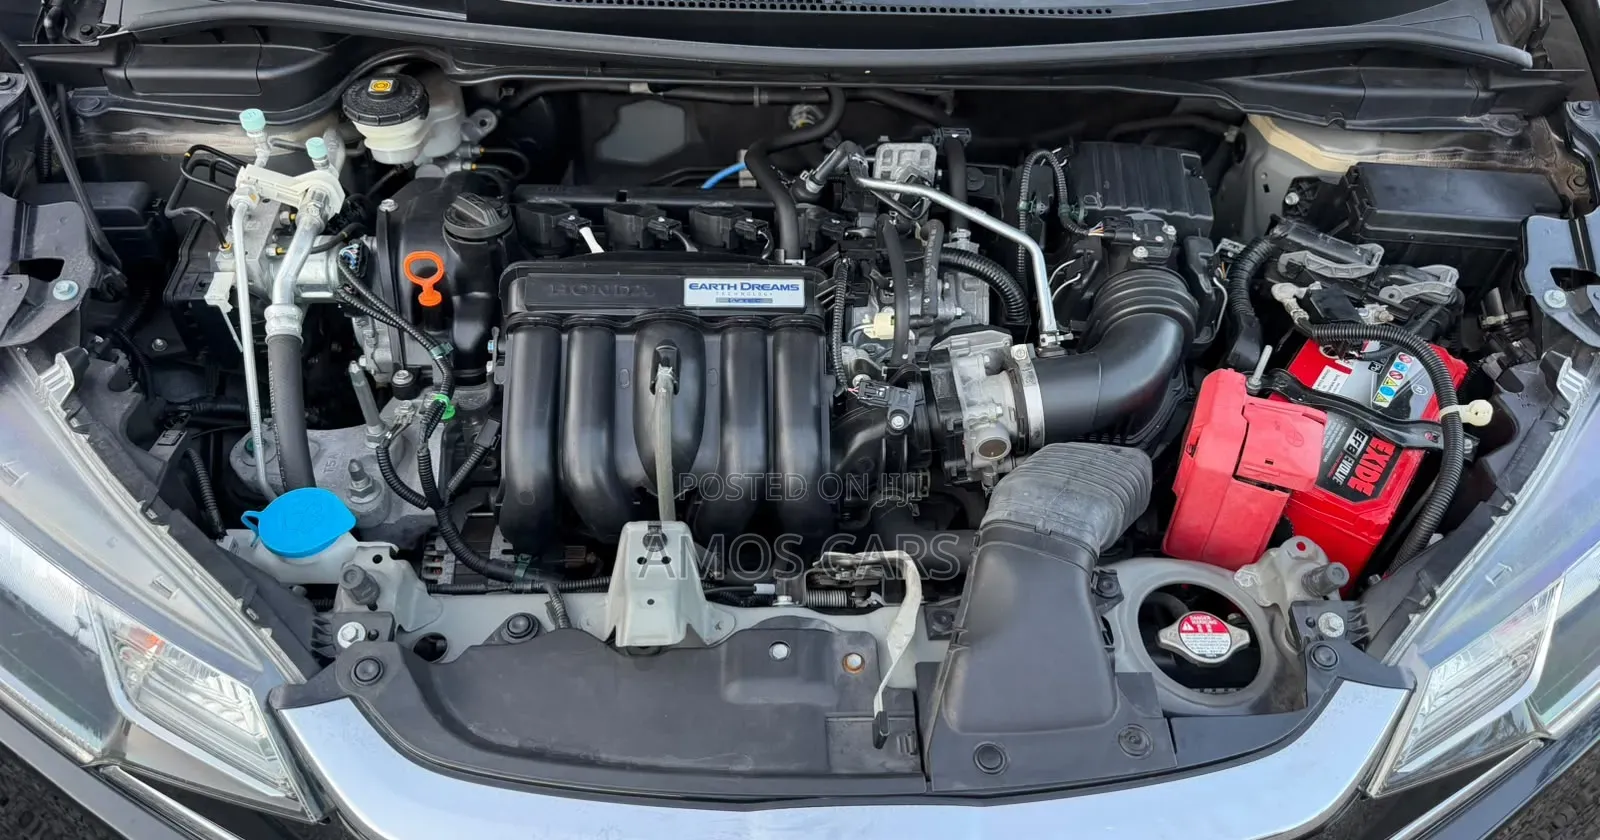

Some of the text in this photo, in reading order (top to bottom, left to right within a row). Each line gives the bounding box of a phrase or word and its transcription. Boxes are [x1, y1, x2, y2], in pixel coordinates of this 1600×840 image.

[547, 283, 656, 298] HONDA
[688, 281, 800, 291] EARTH DREAMS
[1346, 430, 1366, 456] EFB
[1332, 455, 1355, 486] EVOLVE
[1347, 436, 1396, 497] EXIDE
